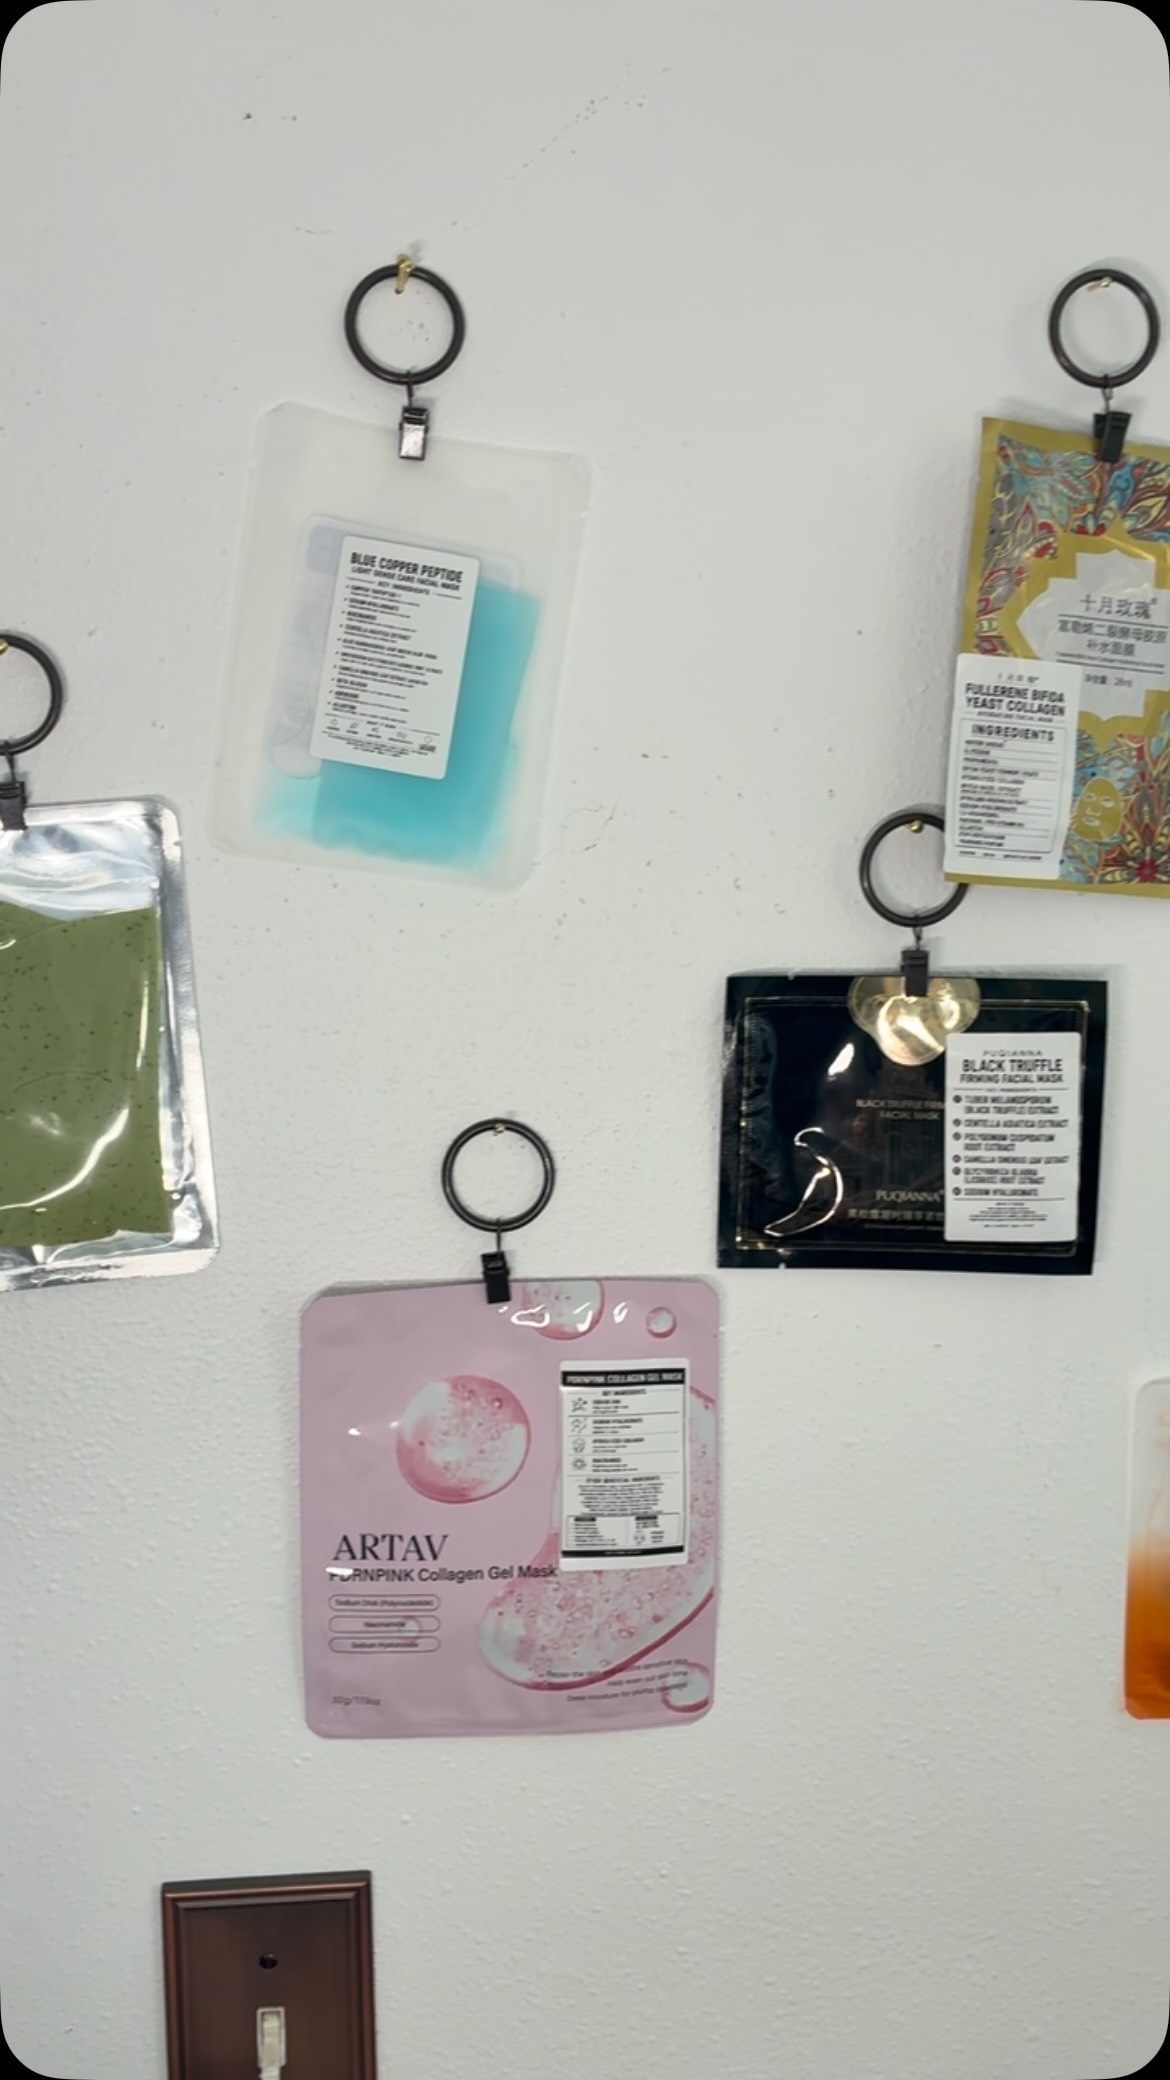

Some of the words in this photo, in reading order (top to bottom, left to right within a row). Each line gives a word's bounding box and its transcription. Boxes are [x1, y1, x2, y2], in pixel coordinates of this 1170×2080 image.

[350, 552, 377, 567] BLUE
[379, 557, 419, 575] COPPER
[420, 564, 463, 583] PEPTIDE
[351, 566, 373, 575] LIGHT
[396, 573, 416, 583] CARE
[965, 683, 1029, 700] FULLERENE
[1032, 689, 1064, 703] BIFIDA
[965, 697, 1003, 710] YEAST
[1006, 700, 1065, 716] COLLAGEN
[972, 724, 1054, 741] INGREDIENTS
[983, 1049, 1043, 1057] PUQIANNA
[962, 1058, 1005, 1072] BLACK
[1008, 1058, 1063, 1072] TRUFFLE
[960, 1073, 1000, 1084] FIRMING
[1001, 1073, 1035, 1083] FACIAL
[1036, 1073, 1064, 1083] MASK
[607, 1374, 645, 1383] COLLAGEN
[333, 1533, 449, 1561] ARTAV
[417, 1566, 485, 1584] Collagen
[487, 1565, 514, 1581] Gel
[517, 1564, 558, 1579] Mask
[335, 1598, 361, 1608] Sodium
[363, 1620, 407, 1629] Niacinamide
[351, 1641, 377, 1650] Sodium
